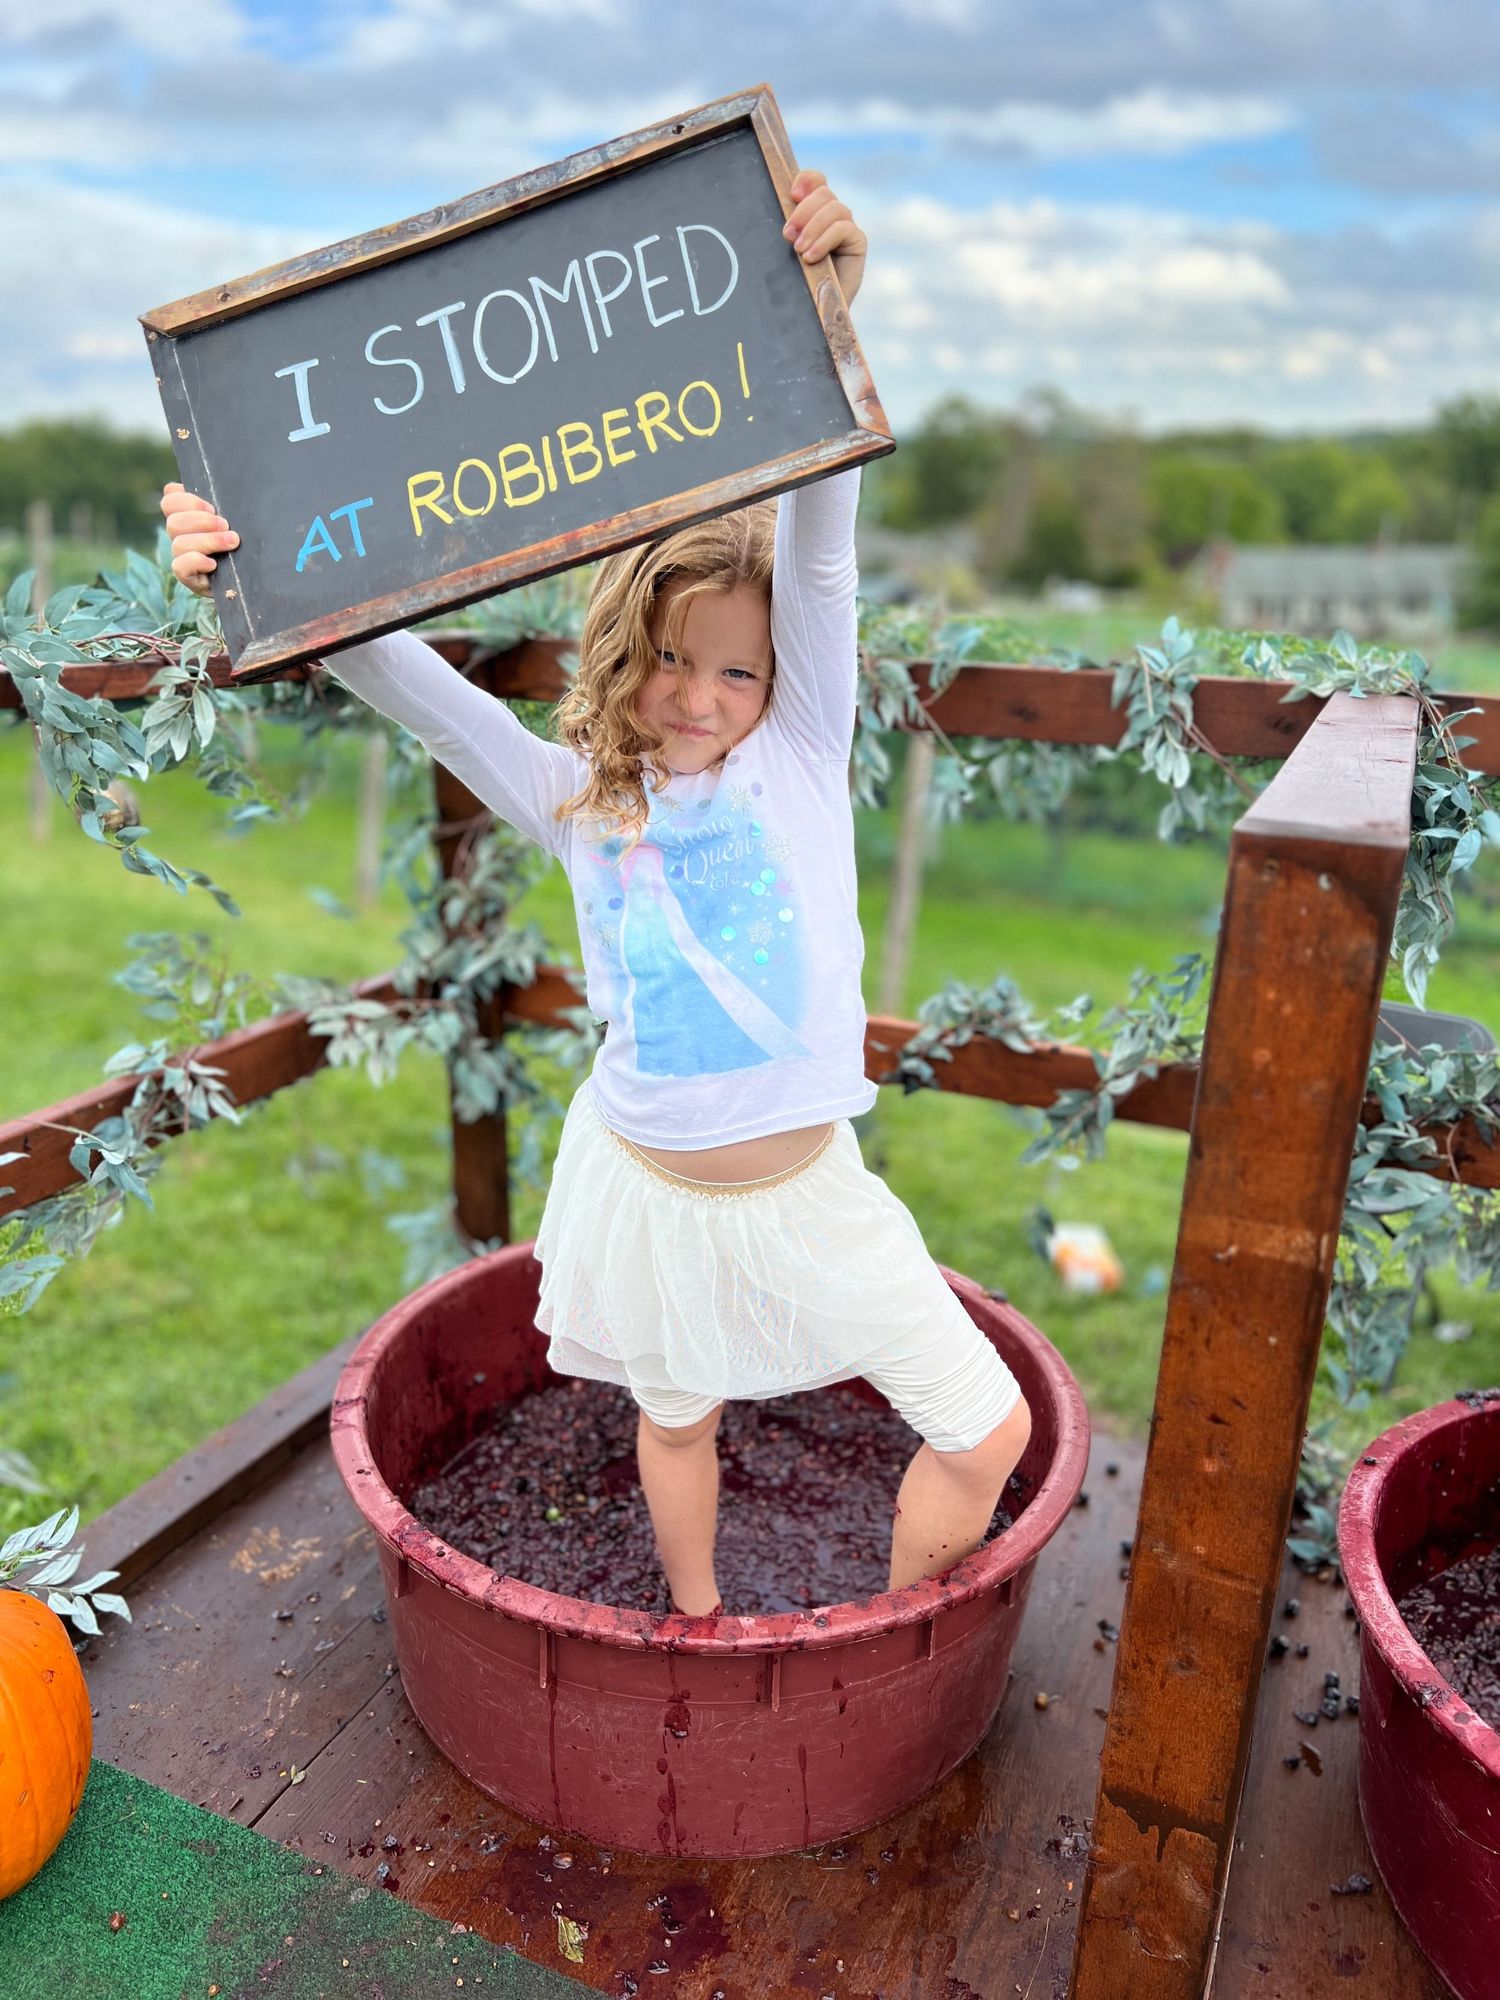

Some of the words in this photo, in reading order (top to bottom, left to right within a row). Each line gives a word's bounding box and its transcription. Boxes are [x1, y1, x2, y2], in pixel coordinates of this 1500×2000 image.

[274, 357, 332, 443] I
[364, 224, 740, 416] STOMPED
[295, 496, 374, 573] AT
[656, 815, 734, 857] Snow
